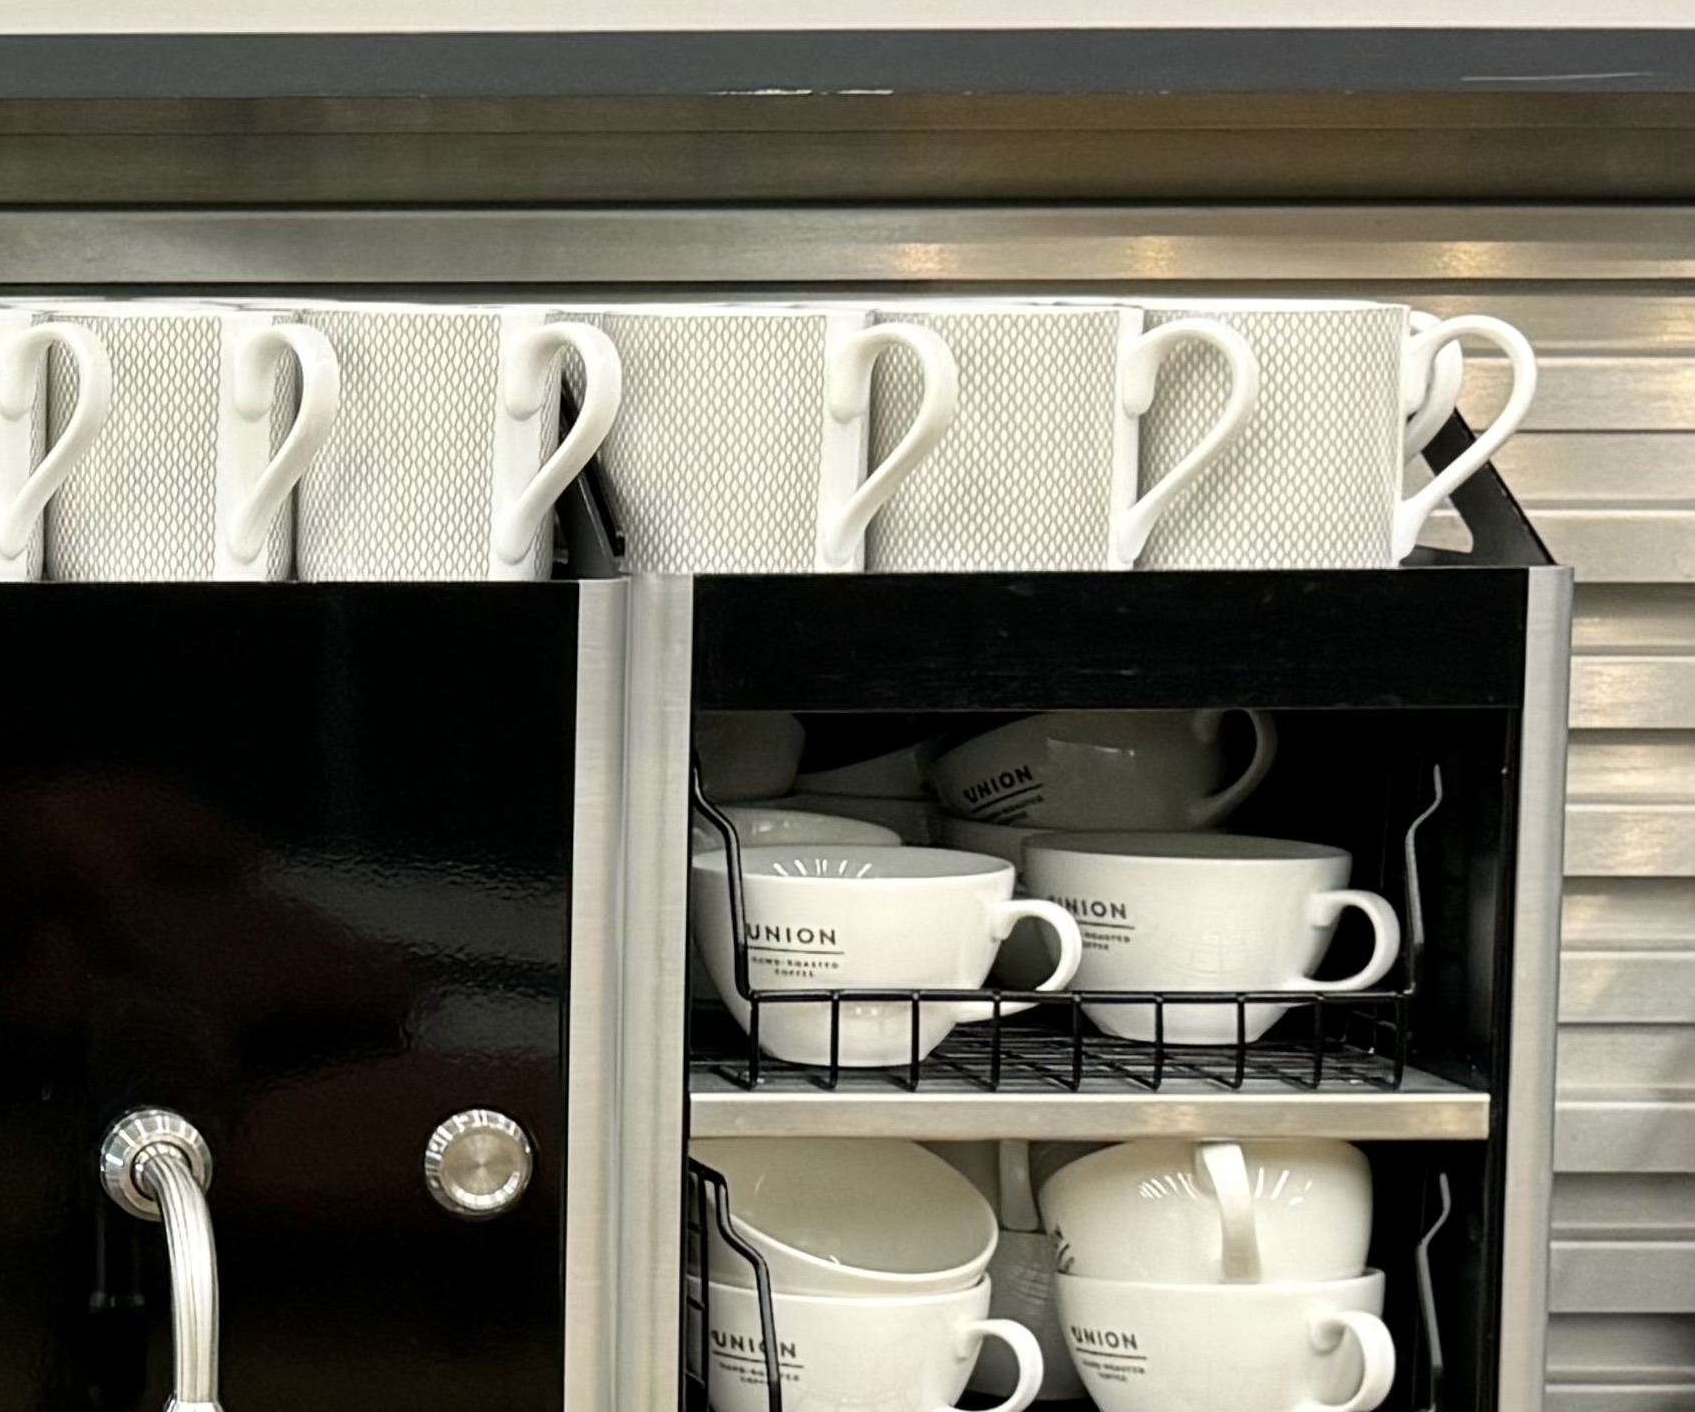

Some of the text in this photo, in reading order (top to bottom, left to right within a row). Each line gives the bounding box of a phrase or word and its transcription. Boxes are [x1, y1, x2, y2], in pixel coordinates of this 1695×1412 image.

[962, 764, 1034, 805] UNION
[744, 923, 837, 946] UNION
[1071, 1325, 1138, 1351] UNION
